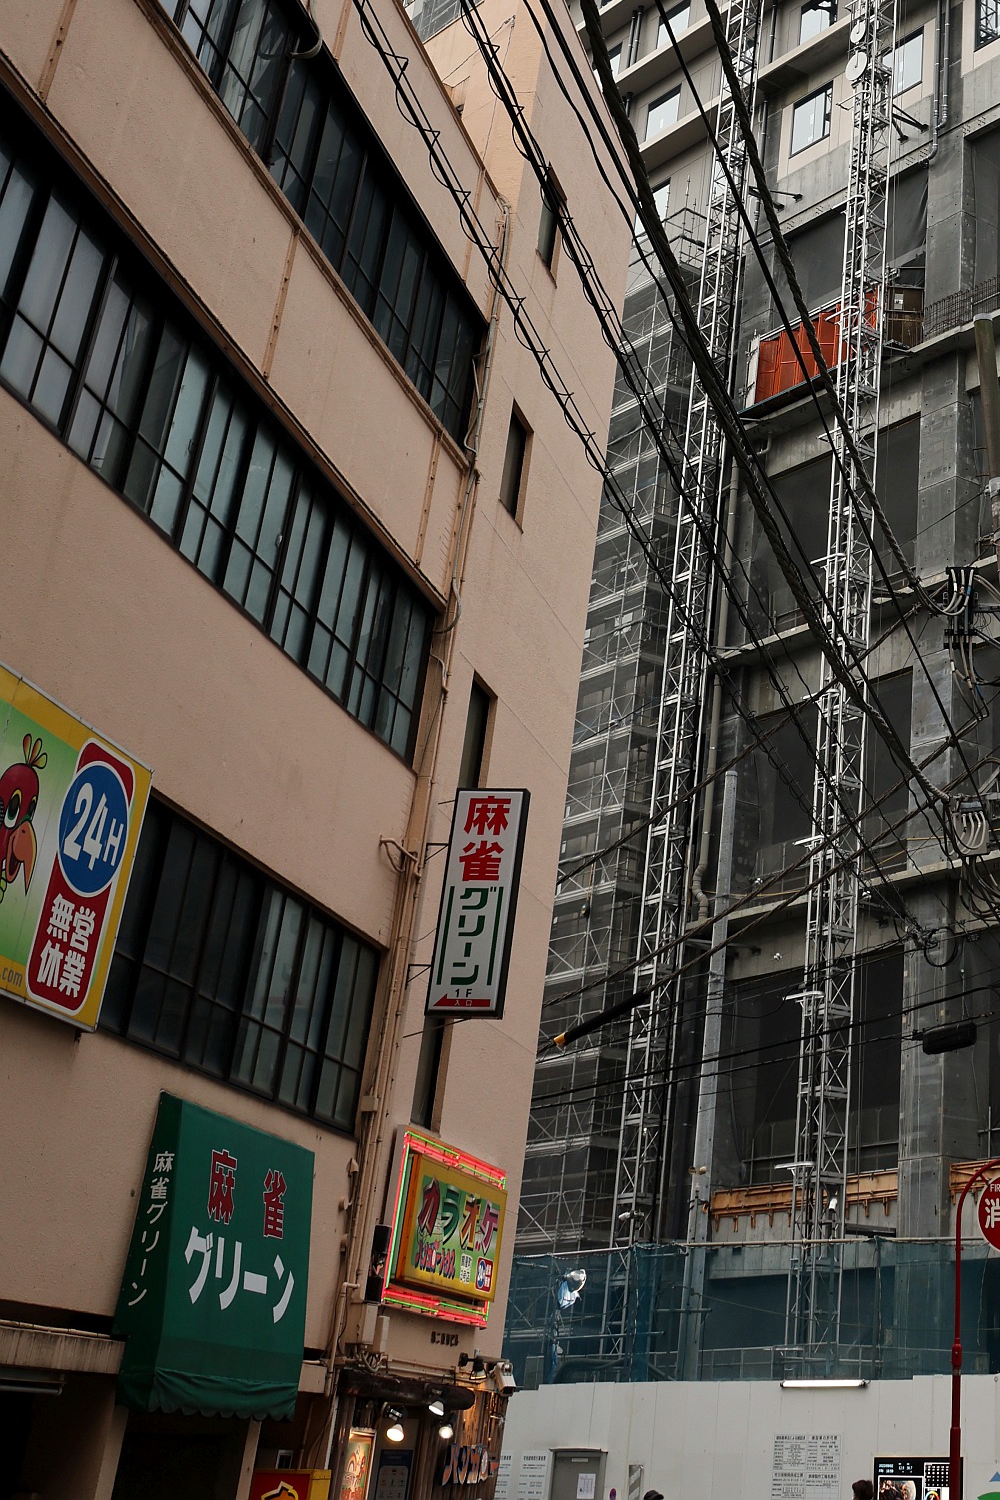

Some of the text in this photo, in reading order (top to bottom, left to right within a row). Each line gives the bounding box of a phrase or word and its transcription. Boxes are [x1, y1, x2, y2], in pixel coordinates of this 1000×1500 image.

[64, 782, 124, 871] 24H
[128, 1151, 175, 1306] 麻雀グリーン
[207, 1149, 287, 1239] 麻雀
[418, 1177, 499, 1256] カラオケ
[184, 1226, 294, 1323] グリーン
